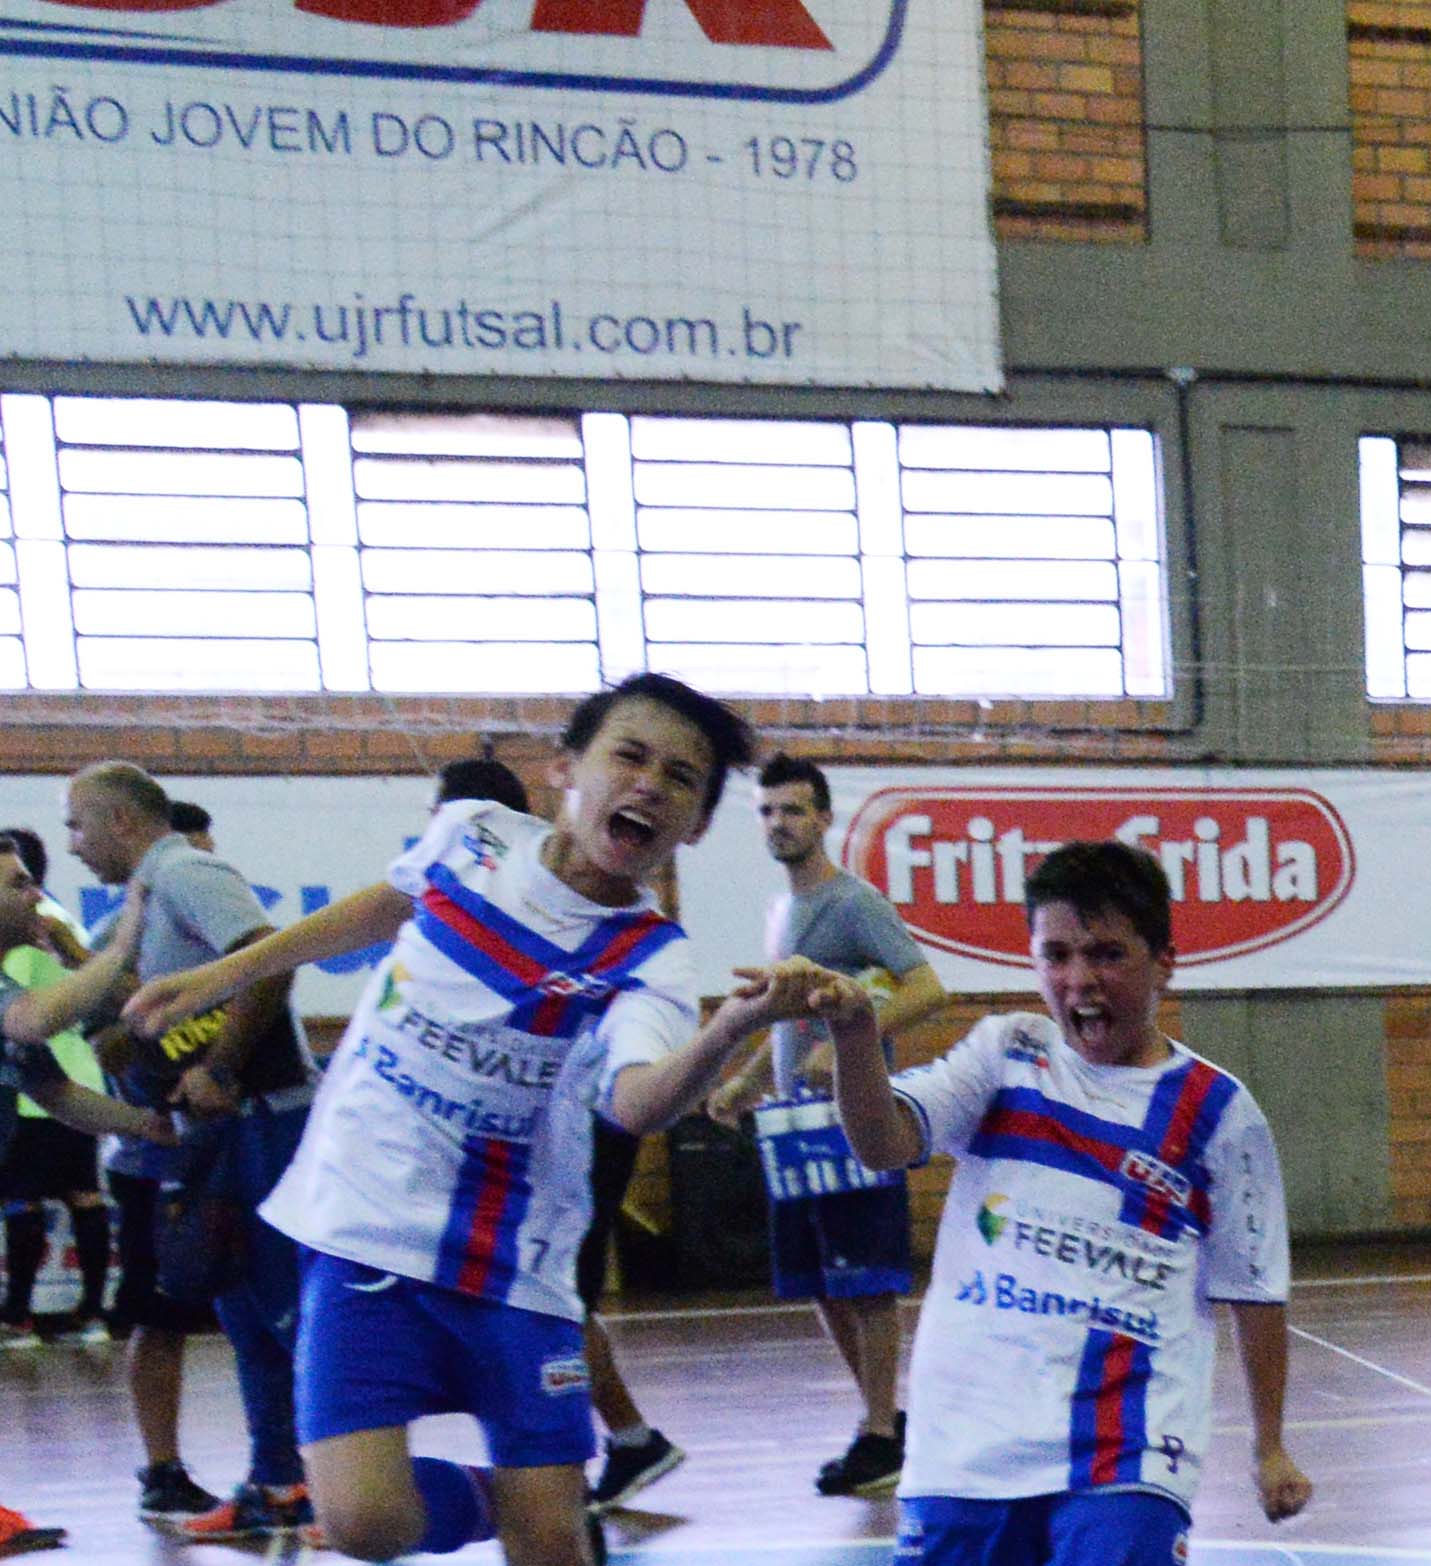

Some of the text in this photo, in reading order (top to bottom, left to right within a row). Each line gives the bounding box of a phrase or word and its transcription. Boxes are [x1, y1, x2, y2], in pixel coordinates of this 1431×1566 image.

[153, 103, 351, 157] JOVEM
[373, 115, 454, 160] DO
[476, 114, 687, 174] RINCÃO
[744, 136, 856, 184] 1978
[126, 294, 801, 361] www.ujrfutsal.com.br
[883, 813, 1062, 904] Frit
[1014, 1220, 1184, 1291] FEEVALE
[994, 1273, 1162, 1340] Banrisul
